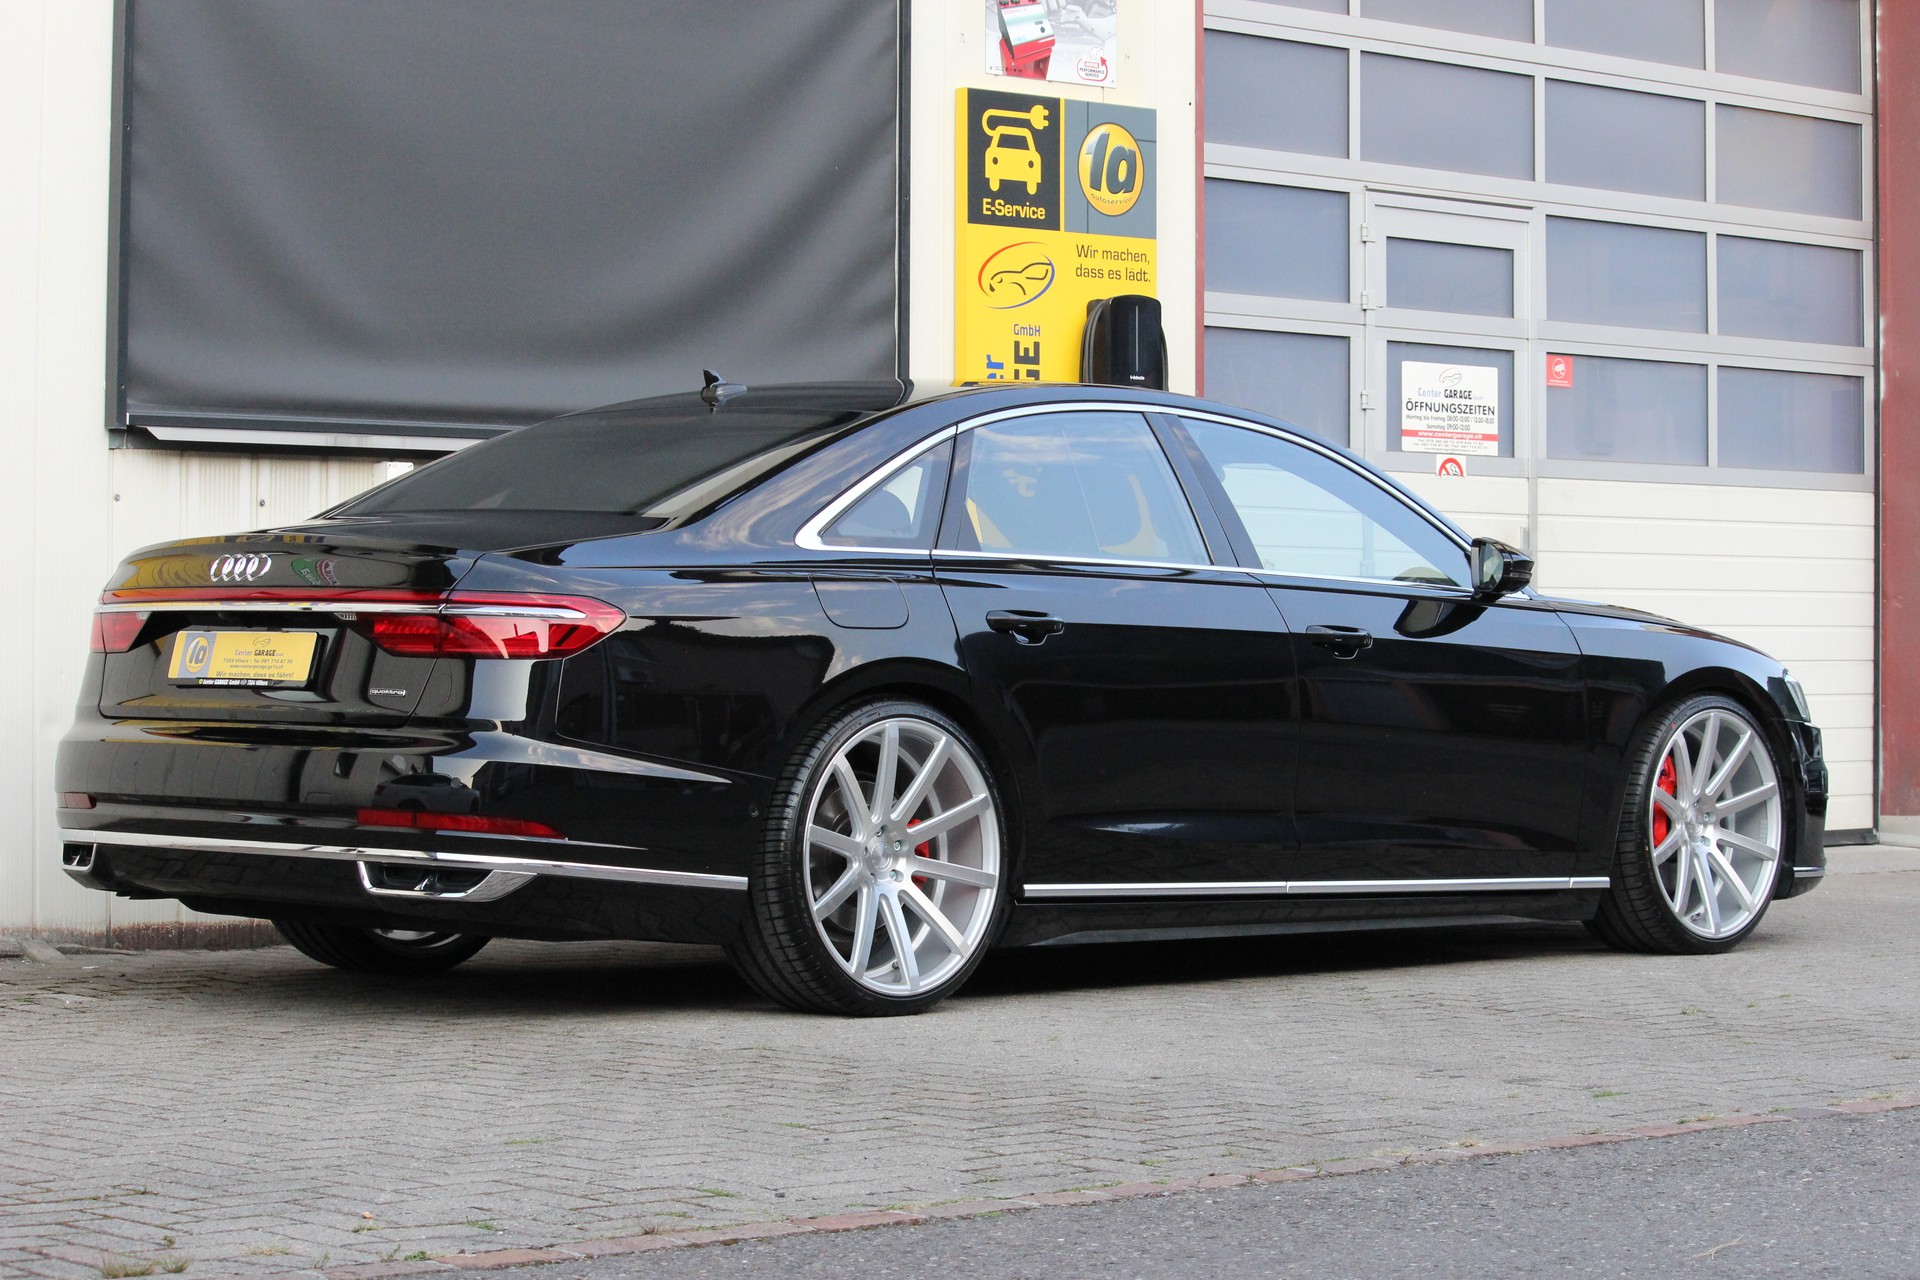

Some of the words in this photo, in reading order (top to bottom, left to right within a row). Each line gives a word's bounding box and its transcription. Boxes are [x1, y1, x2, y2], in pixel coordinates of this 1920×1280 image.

[1090, 194, 1133, 205] autoservice
[982, 198, 1046, 220] E-Service
[1076, 243, 1098, 259] Wir
[1102, 248, 1150, 265] machen,
[1076, 263, 1104, 278] dass
[1108, 269, 1121, 280] es
[1126, 267, 1150, 282] lädt.
[1014, 324, 1040, 336] GmbH
[1418, 387, 1441, 398] Center
[1444, 389, 1472, 400] GARAGE
[1406, 398, 1495, 416] ÖFFNUNGSZEITEN
[1418, 432, 1483, 440] www.centergarage.ch
